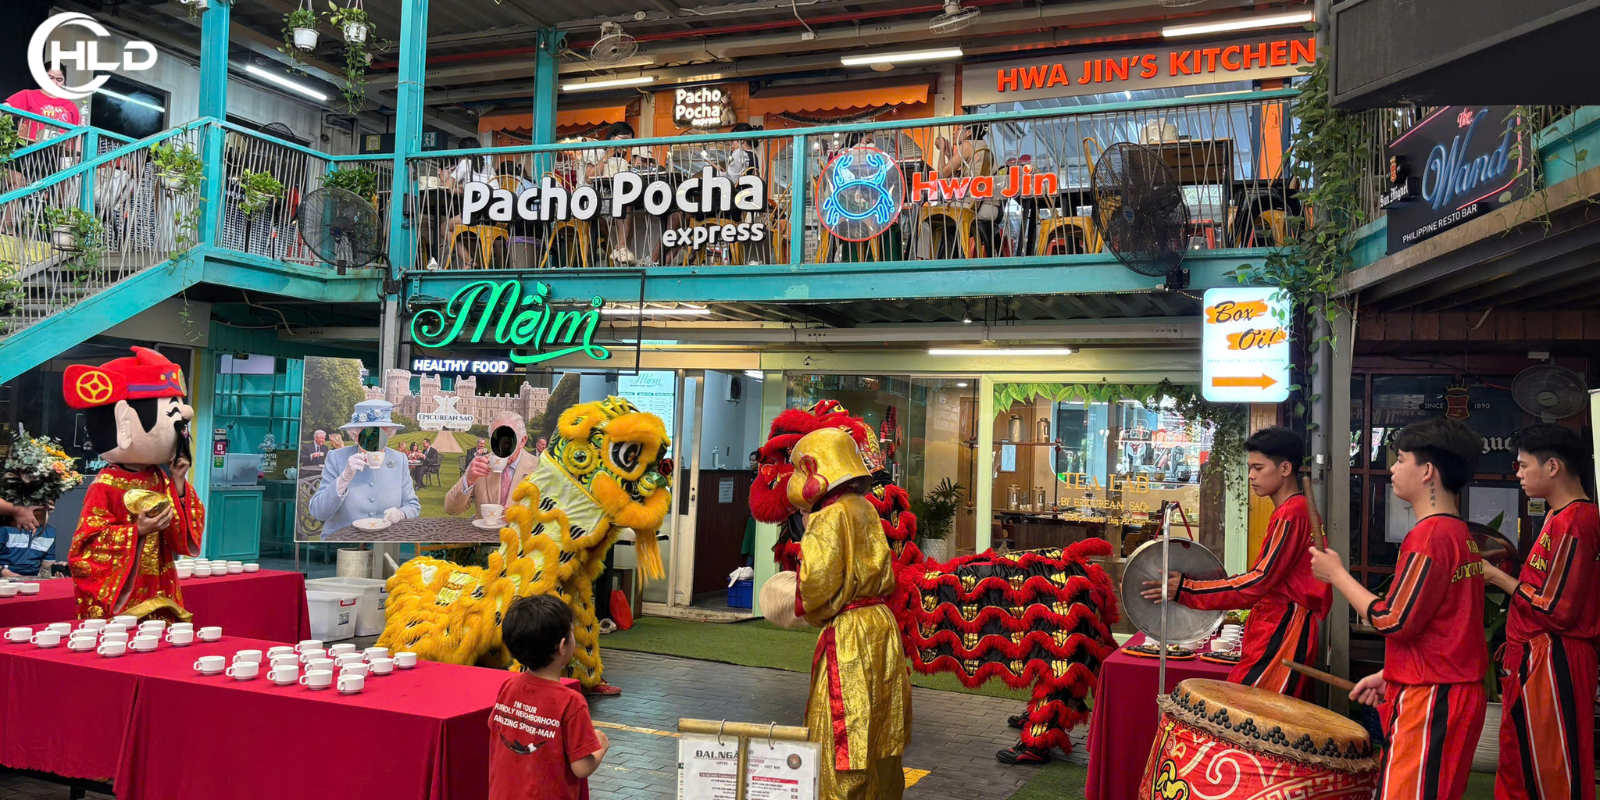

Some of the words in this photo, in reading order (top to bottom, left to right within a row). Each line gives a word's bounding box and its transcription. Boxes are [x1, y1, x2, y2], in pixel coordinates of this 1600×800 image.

[997, 63, 1069, 92] HWA
[1077, 54, 1158, 84] JIN'S
[1169, 38, 1316, 76] KITCHEN
[676, 88, 721, 104] Pacho
[676, 103, 720, 120] Pocha
[1421, 108, 1514, 210] Wand
[912, 170, 993, 202] Hwa
[1001, 165, 1058, 198] Jin
[462, 176, 598, 225] Pacho
[612, 165, 764, 218] Pocha
[1402, 222, 1437, 243] PHILIPPINE
[1438, 210, 1461, 227] RESTO
[1461, 203, 1478, 218] BAR
[663, 222, 765, 249] express
[1215, 301, 1254, 323] Box
[414, 359, 469, 371] HEALTHY
[472, 361, 509, 373] FOOD
[1062, 472, 1102, 491] TEA
[1108, 474, 1150, 494] LAB
[1060, 497, 1070, 506] BY
[1074, 498, 1125, 510] EPICUREAN
[515, 709, 560, 728] NEIGHBORHOOD
